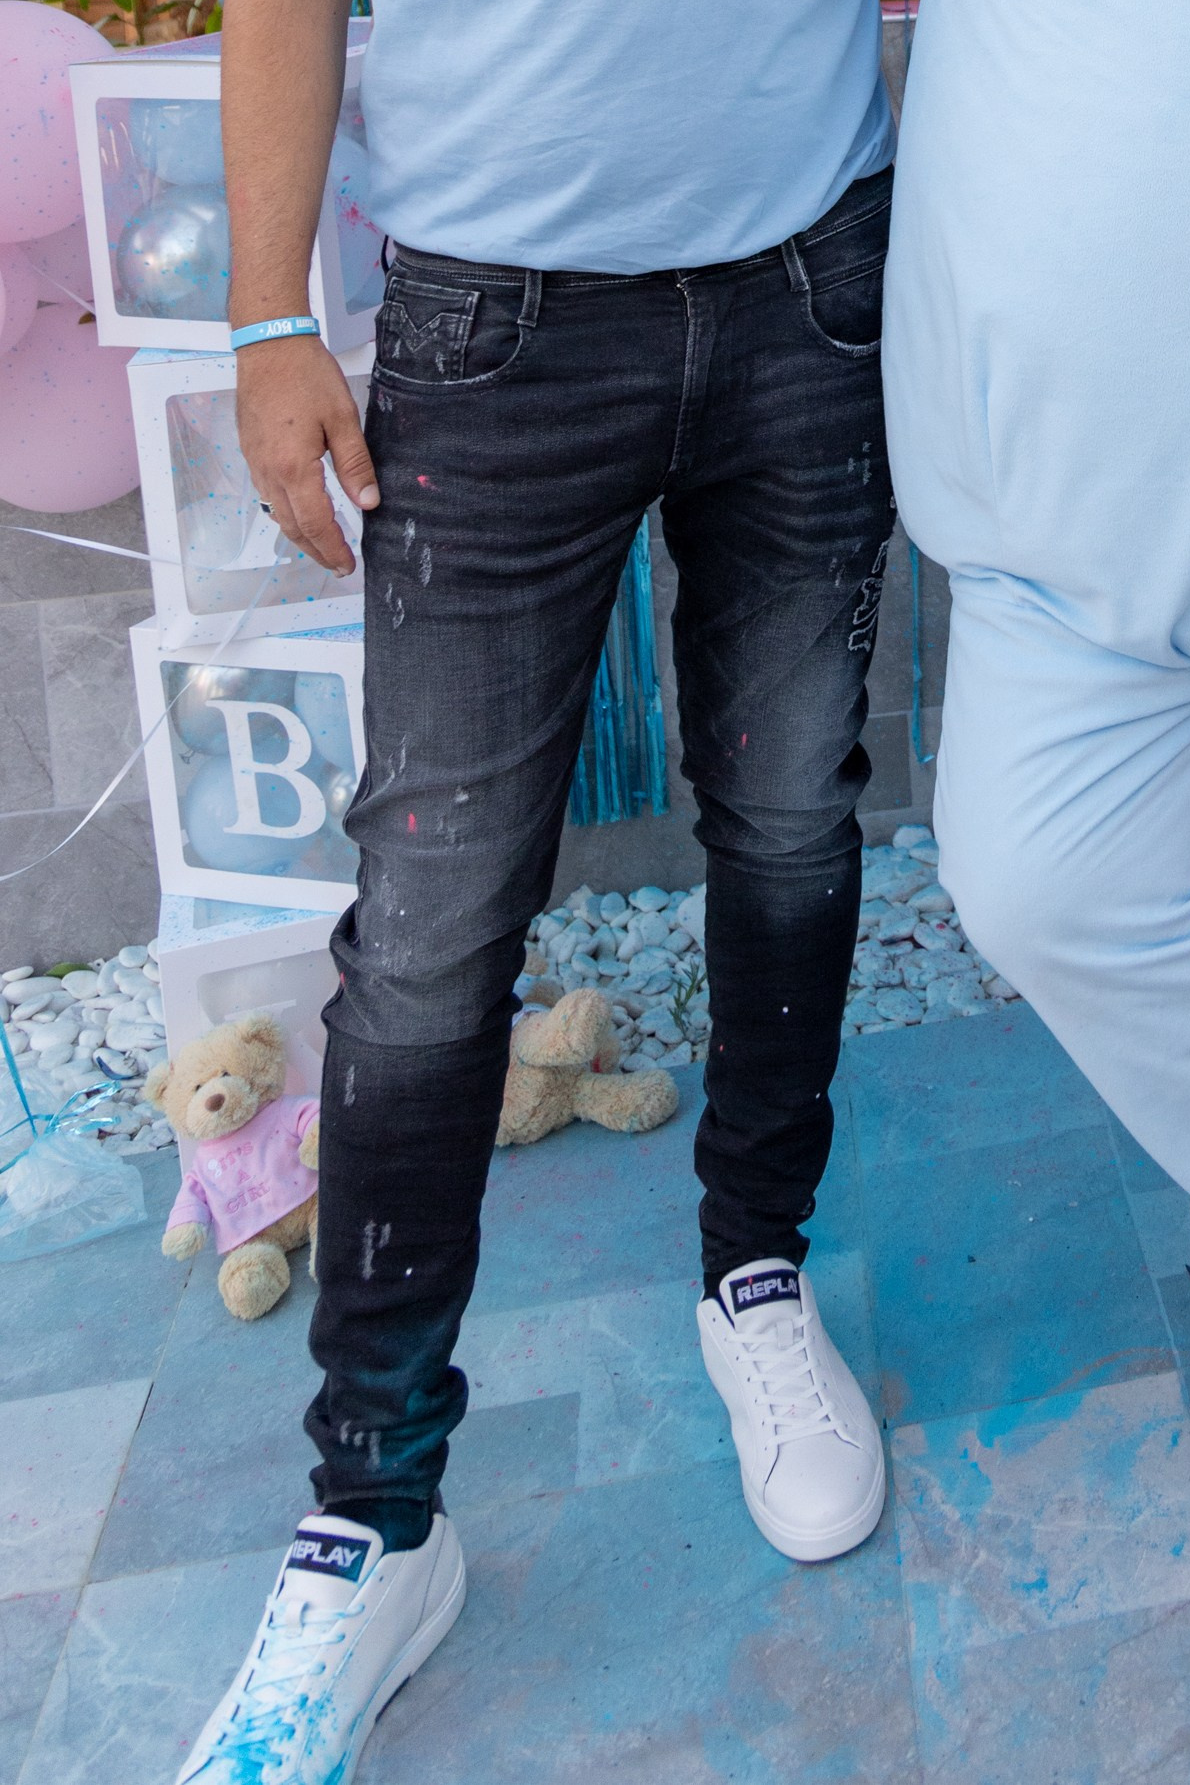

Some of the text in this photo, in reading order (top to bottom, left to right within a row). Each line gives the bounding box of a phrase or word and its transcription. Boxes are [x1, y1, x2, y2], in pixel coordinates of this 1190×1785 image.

[266, 320, 293, 337] BOY
[205, 699, 327, 840] B
[225, 1182, 270, 1214] GIRL
